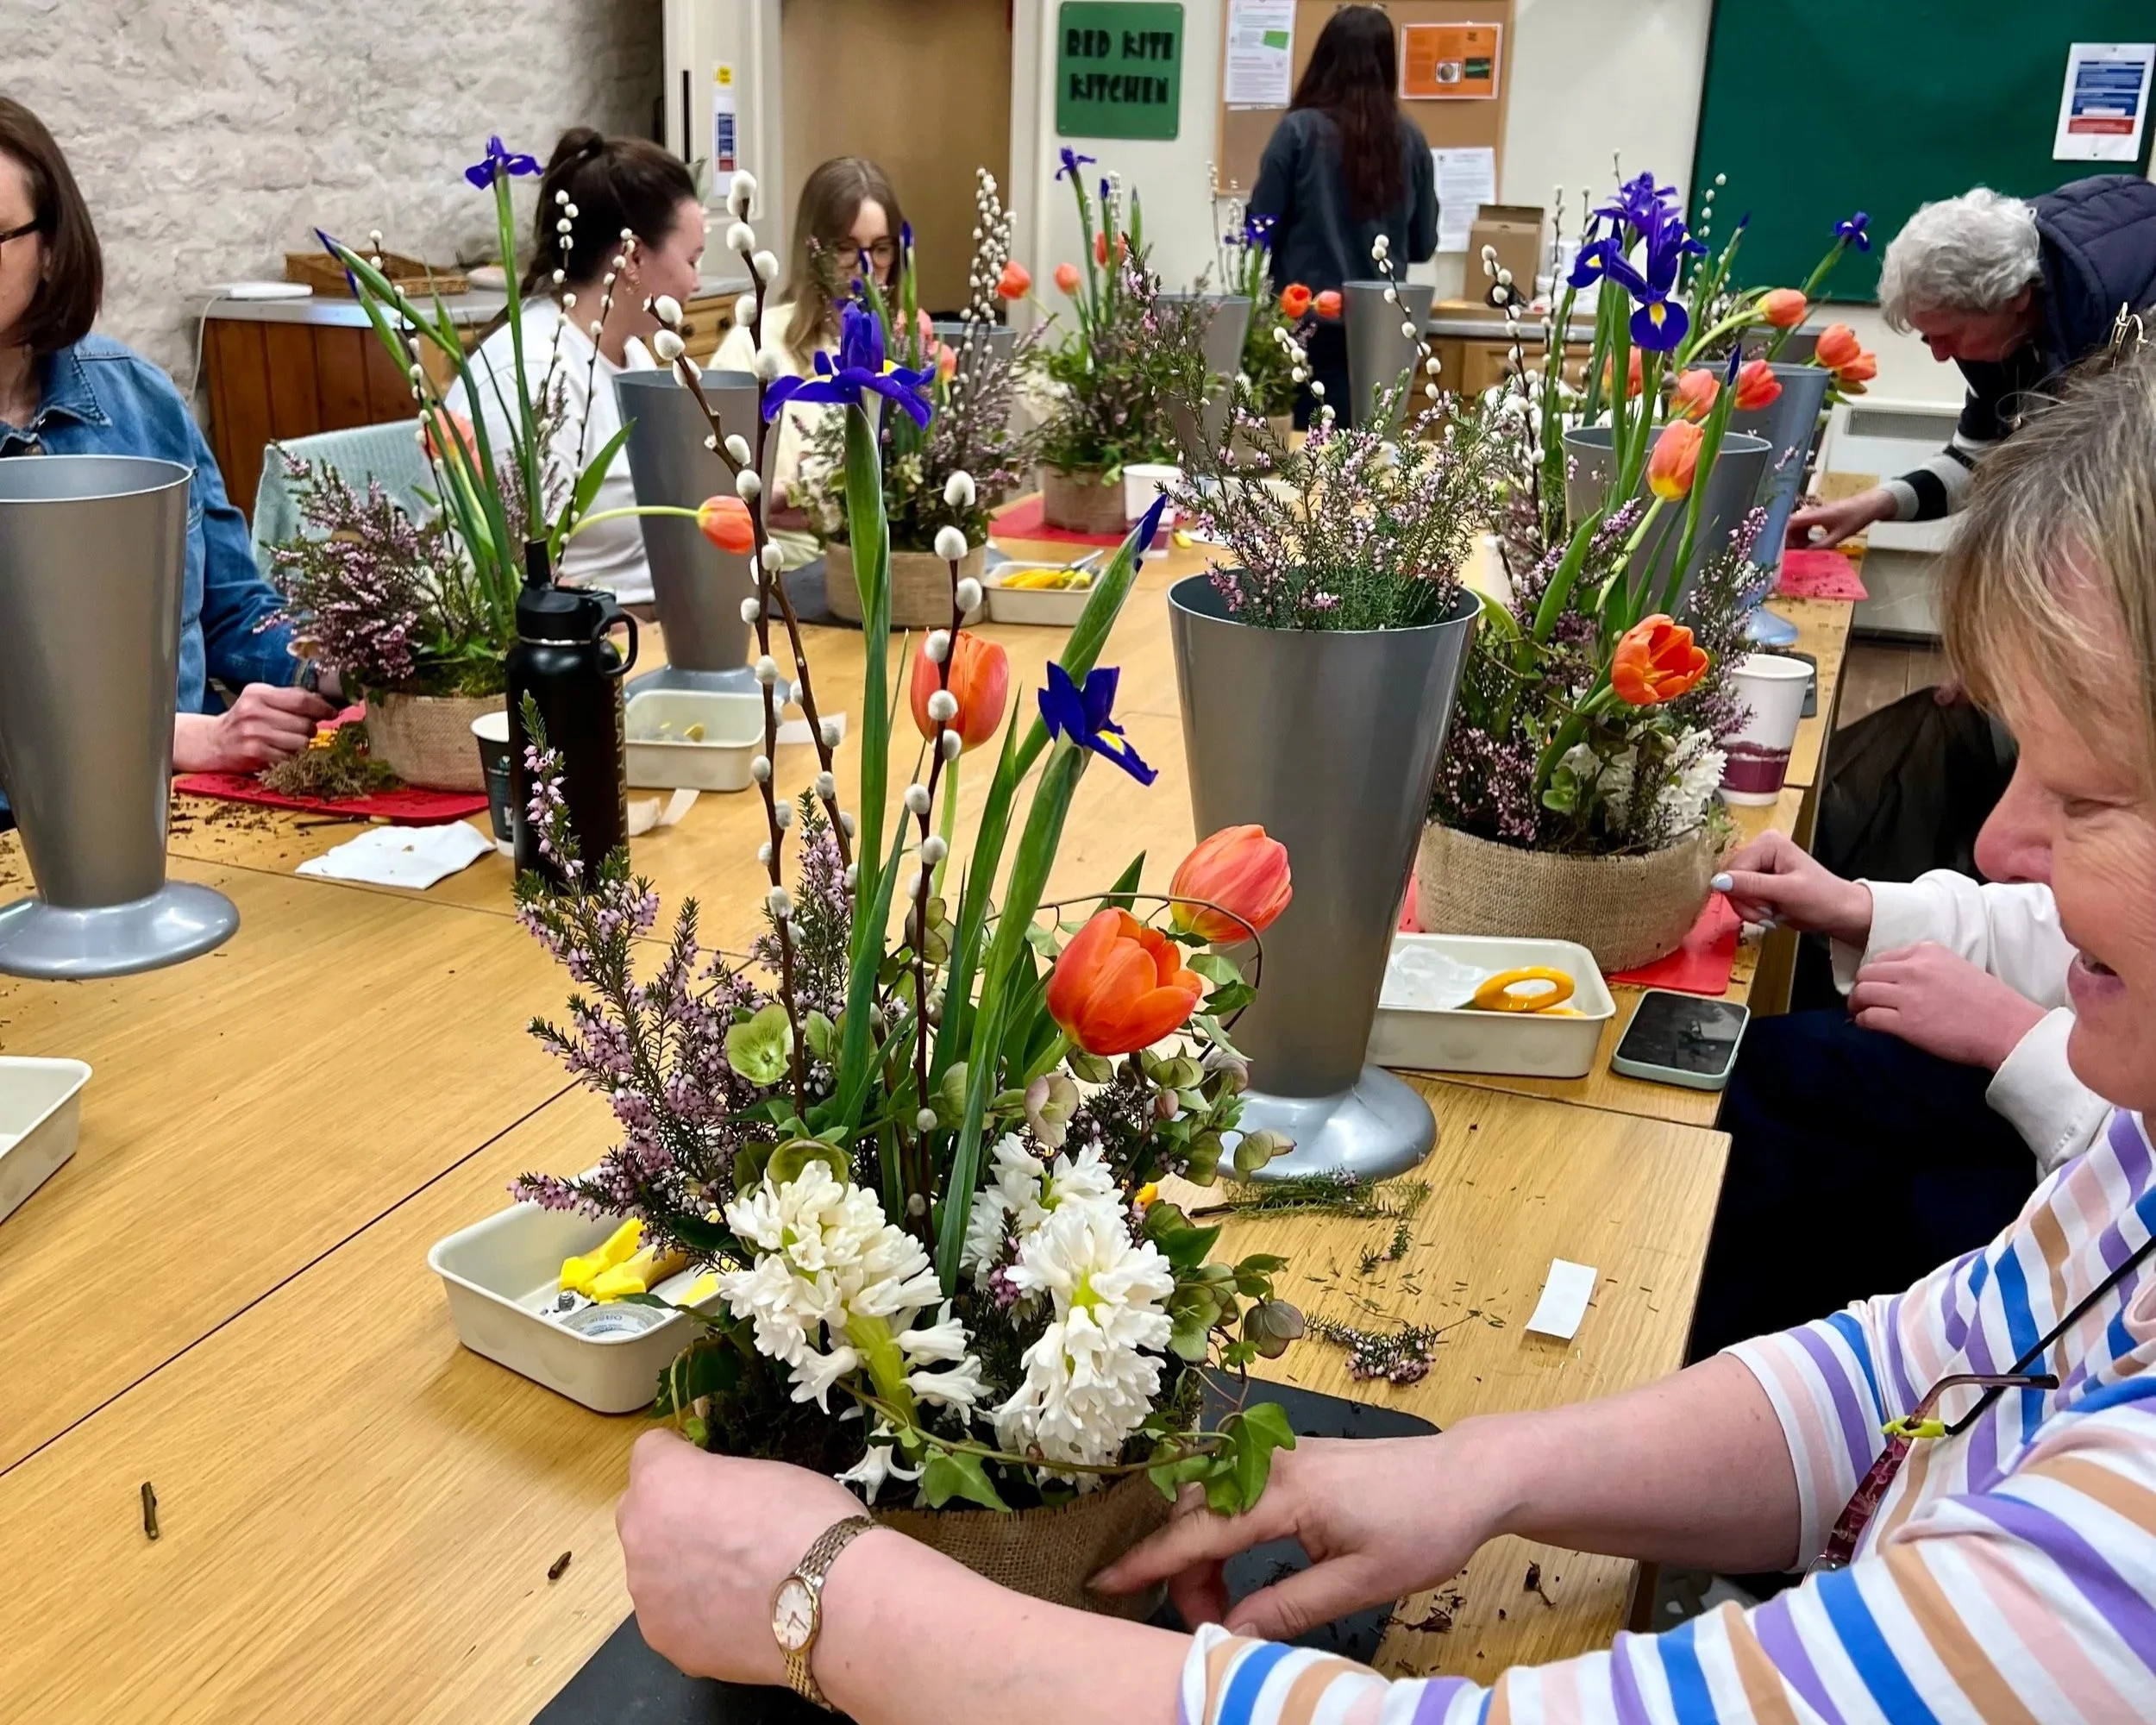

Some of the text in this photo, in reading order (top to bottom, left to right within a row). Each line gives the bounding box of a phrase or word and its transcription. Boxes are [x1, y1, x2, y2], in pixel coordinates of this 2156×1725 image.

[1067, 28, 1174, 61] RED KITE
[1069, 72, 1169, 104] KITCHEN
[617, 779, 628, 840] BETT
